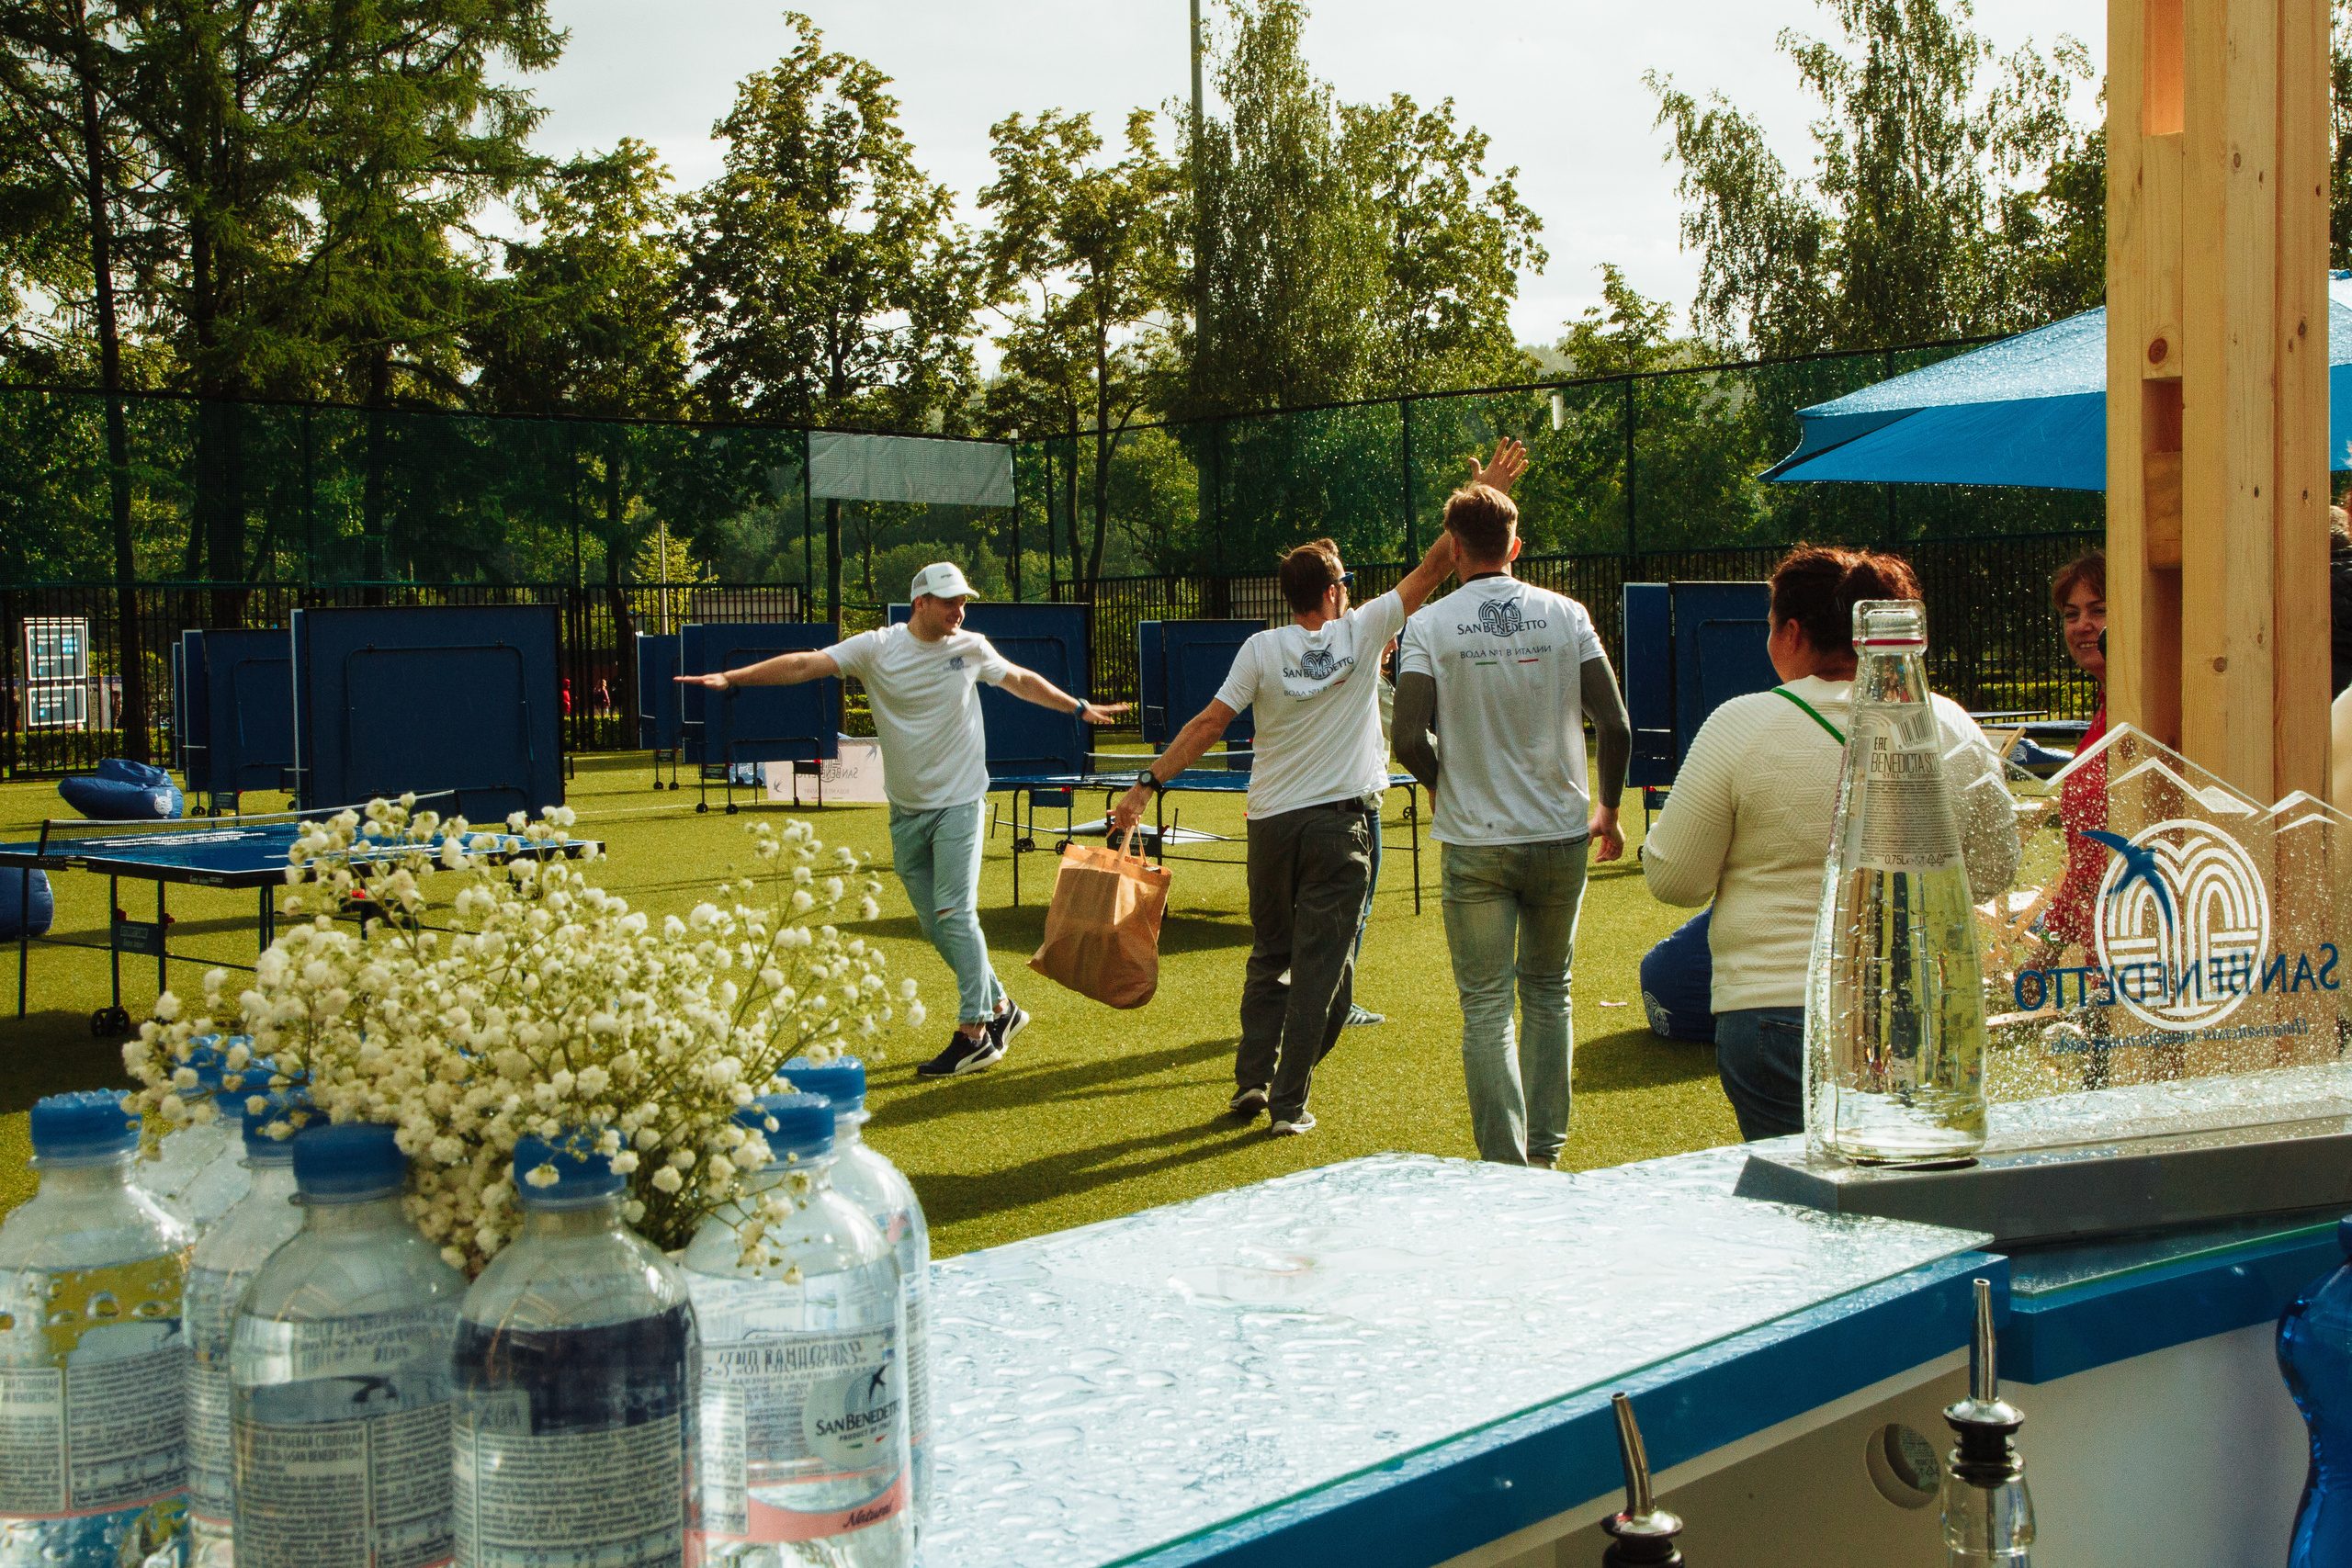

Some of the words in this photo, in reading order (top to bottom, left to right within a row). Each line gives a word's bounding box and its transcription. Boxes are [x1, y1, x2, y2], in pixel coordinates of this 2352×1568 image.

[1460, 650, 1487, 660] ВОДА
[1507, 649, 1512, 657] В
[1515, 645, 1552, 656] ИТАЛИИ
